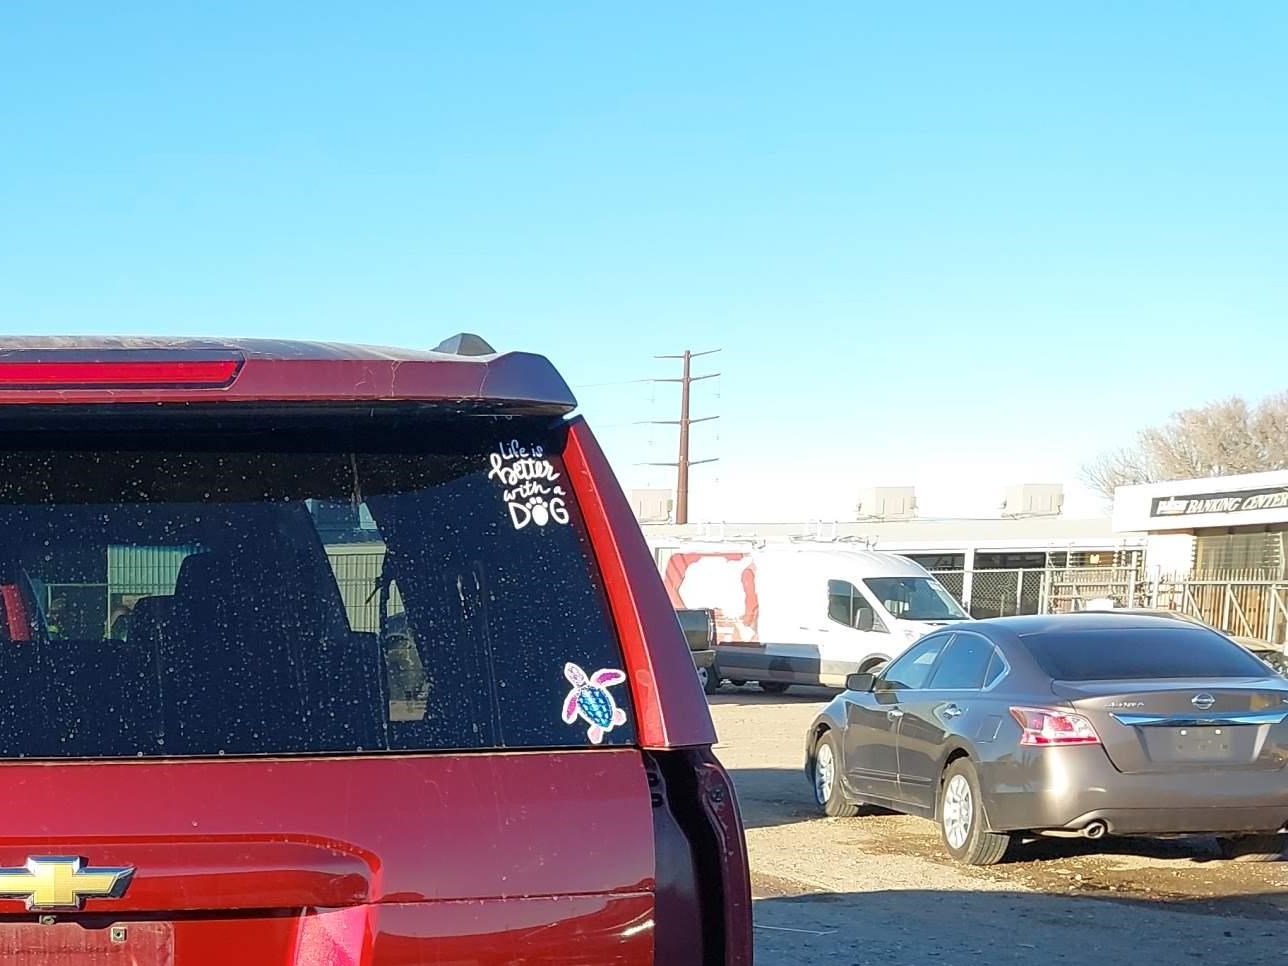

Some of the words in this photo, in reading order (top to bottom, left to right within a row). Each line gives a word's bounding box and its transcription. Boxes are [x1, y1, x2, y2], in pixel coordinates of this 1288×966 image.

[499, 439, 529, 459] Life
[531, 442, 544, 457] is
[488, 453, 560, 485] better
[503, 481, 551, 502] with
[553, 486, 566, 496] a
[1186, 497, 1242, 514] BANKING
